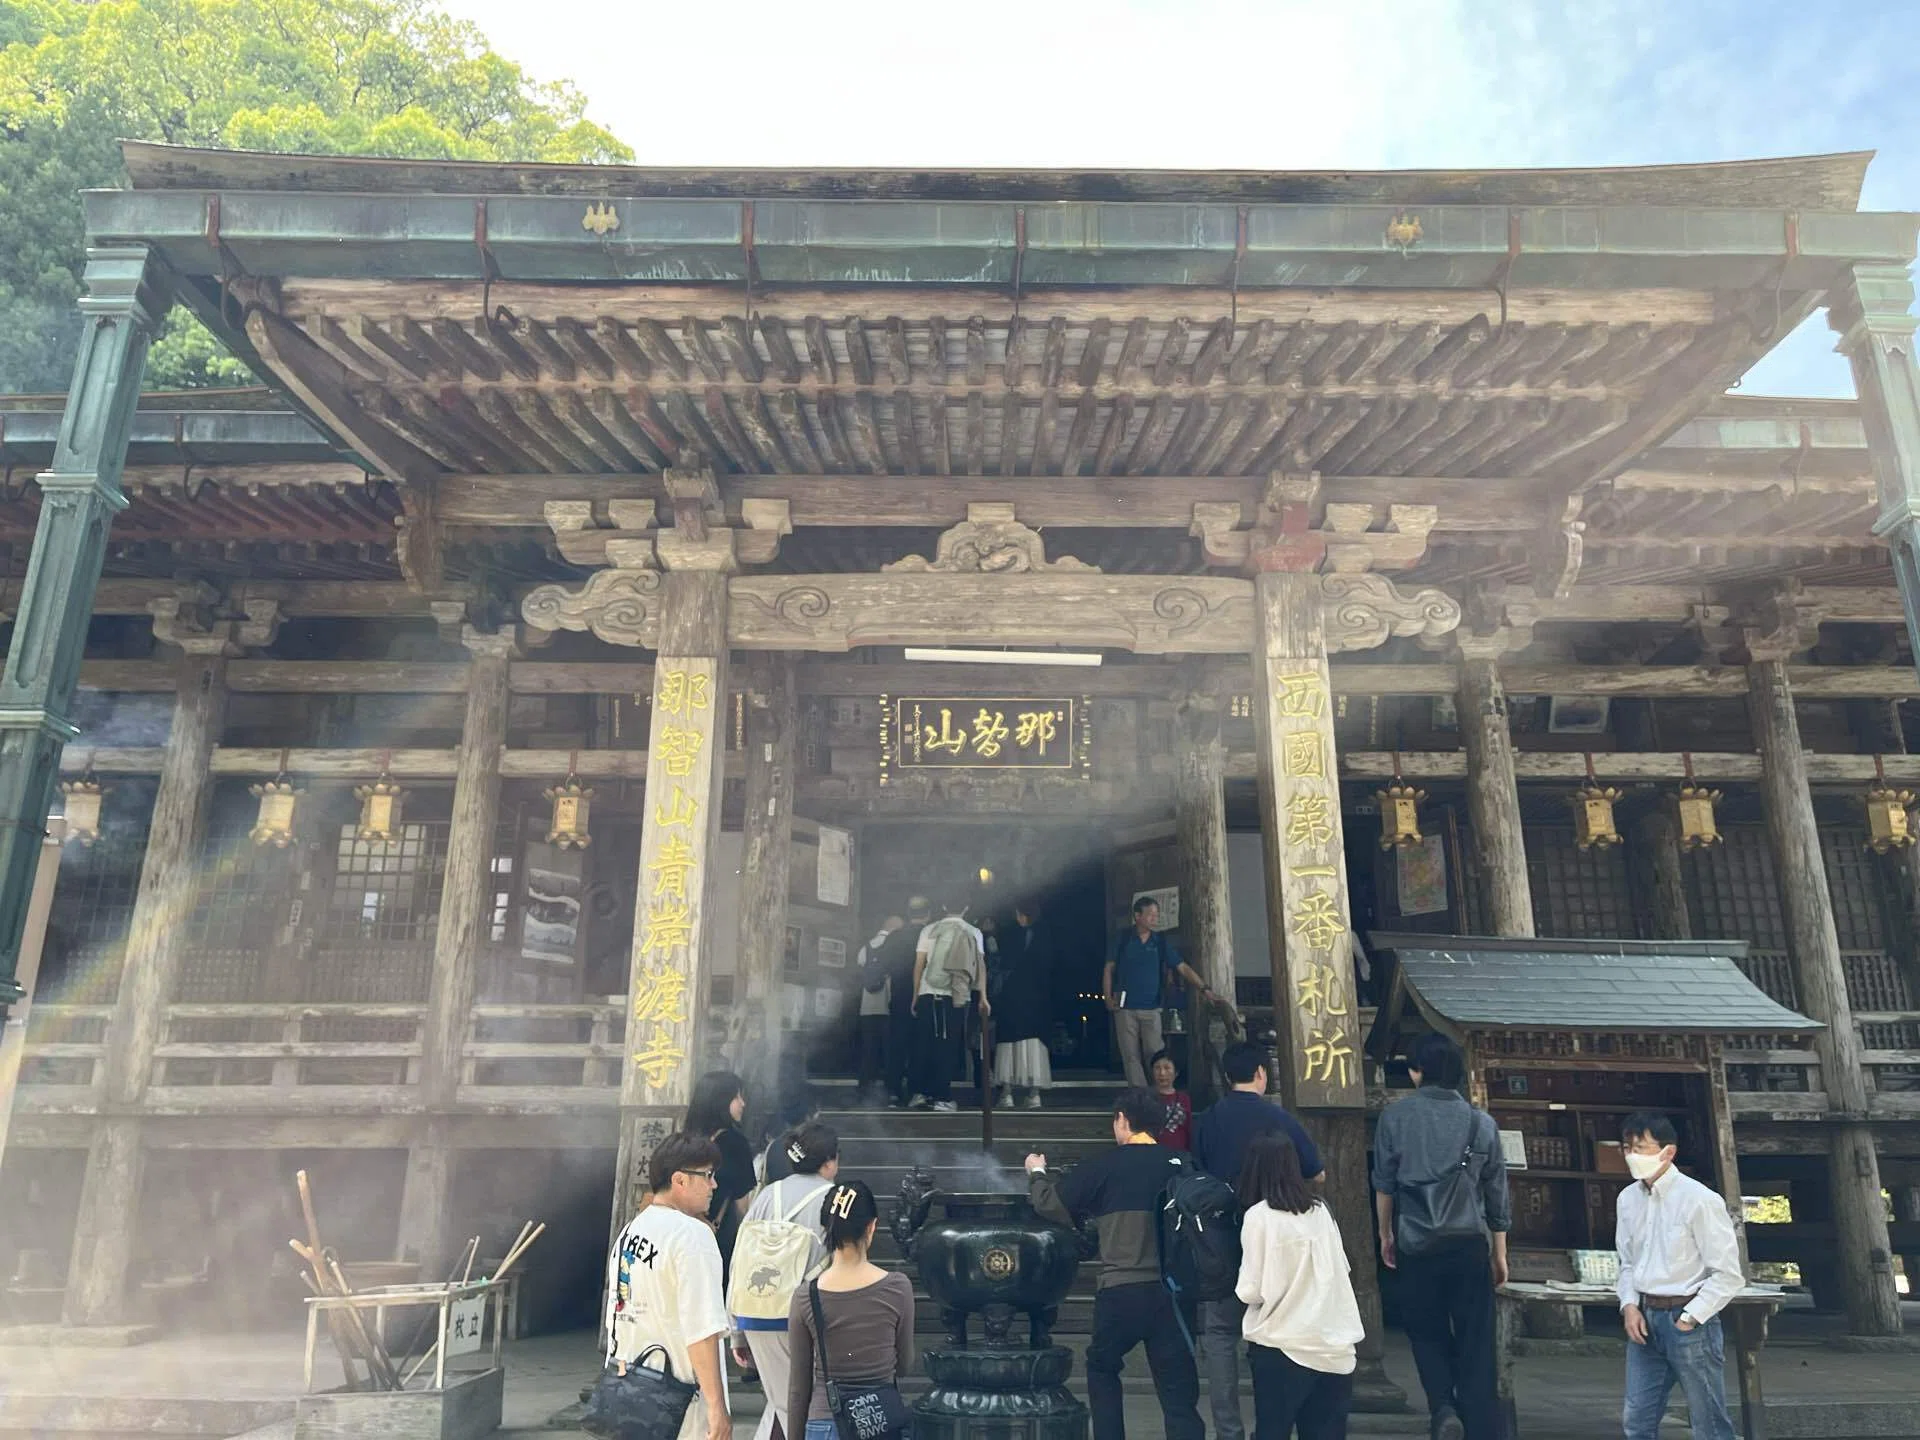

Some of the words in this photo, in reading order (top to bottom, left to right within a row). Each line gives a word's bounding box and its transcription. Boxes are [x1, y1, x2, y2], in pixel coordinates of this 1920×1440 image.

[632, 671, 709, 1089] 那智山青岸渡寺
[1275, 671, 1352, 1089] 西國第一番札所
